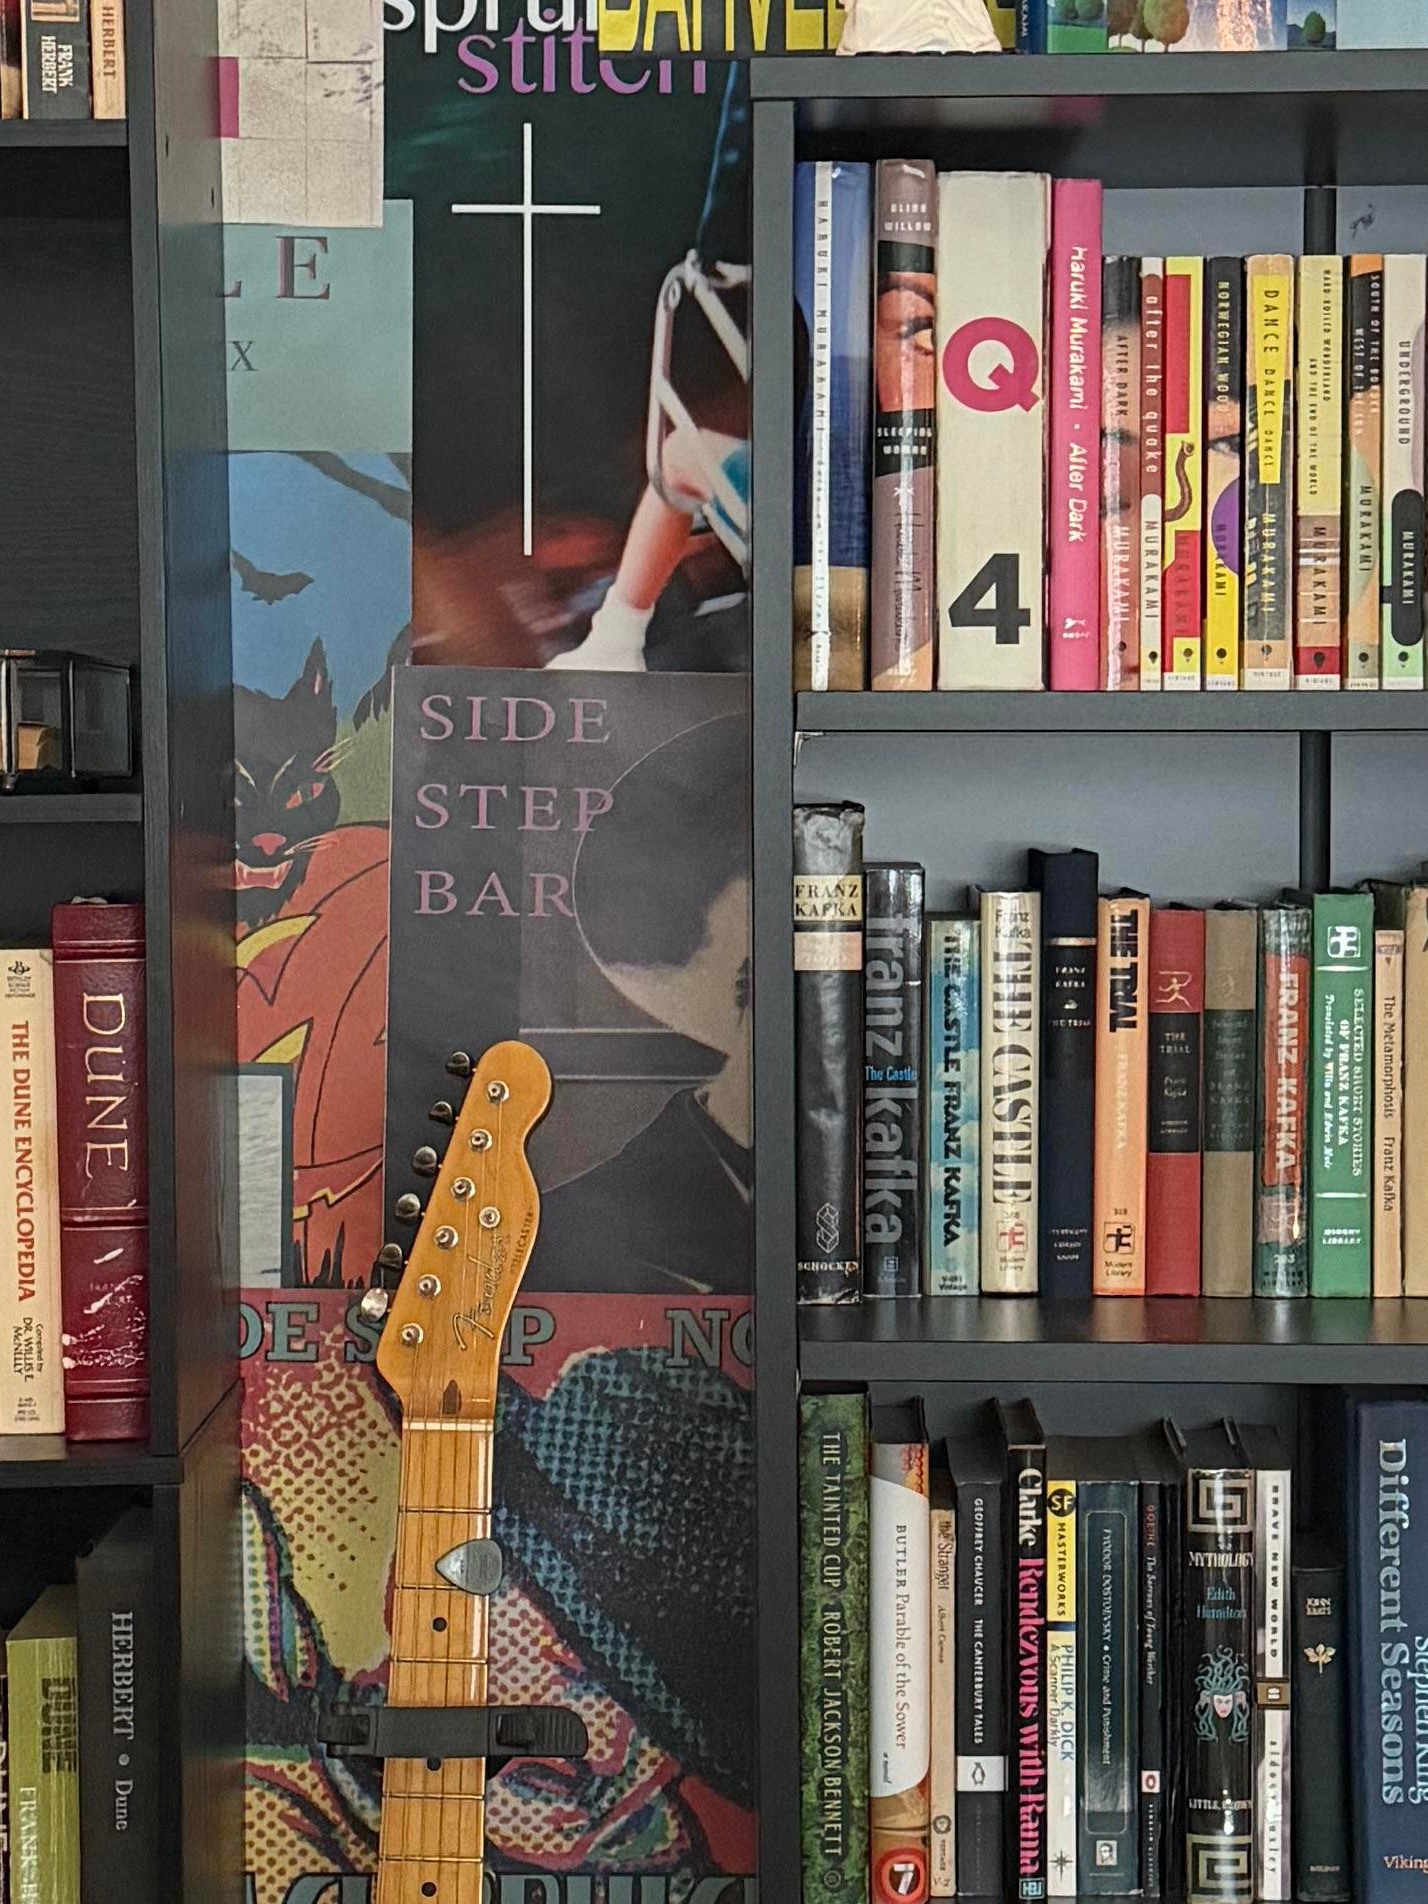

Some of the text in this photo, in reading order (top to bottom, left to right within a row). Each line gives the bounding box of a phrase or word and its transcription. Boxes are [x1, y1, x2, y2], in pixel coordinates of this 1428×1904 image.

[100, 3, 118, 79] HERBERT
[942, 316, 1041, 413] Q
[1067, 245, 1089, 544] Haruki Murakami After Dark
[947, 553, 1031, 646] 4
[419, 695, 612, 745] SIDE
[415, 783, 615, 832] STEP
[413, 870, 575, 918] BAR
[794, 902, 859, 918] KAFKA
[82, 991, 129, 1179] DUNE
[991, 1045, 1033, 1205] CASTLE
[11, 1020, 36, 1304] THE DUNE ENCYCLOPEDIA
[1187, 1550, 1255, 1567] MYTHOLOGY
[823, 1609, 841, 1679] ROBERT
[1019, 1557, 1045, 1719] Rendezvous
[1377, 1439, 1409, 1804] Different Seasons
[111, 1612, 136, 1832] HERBERT Dune
